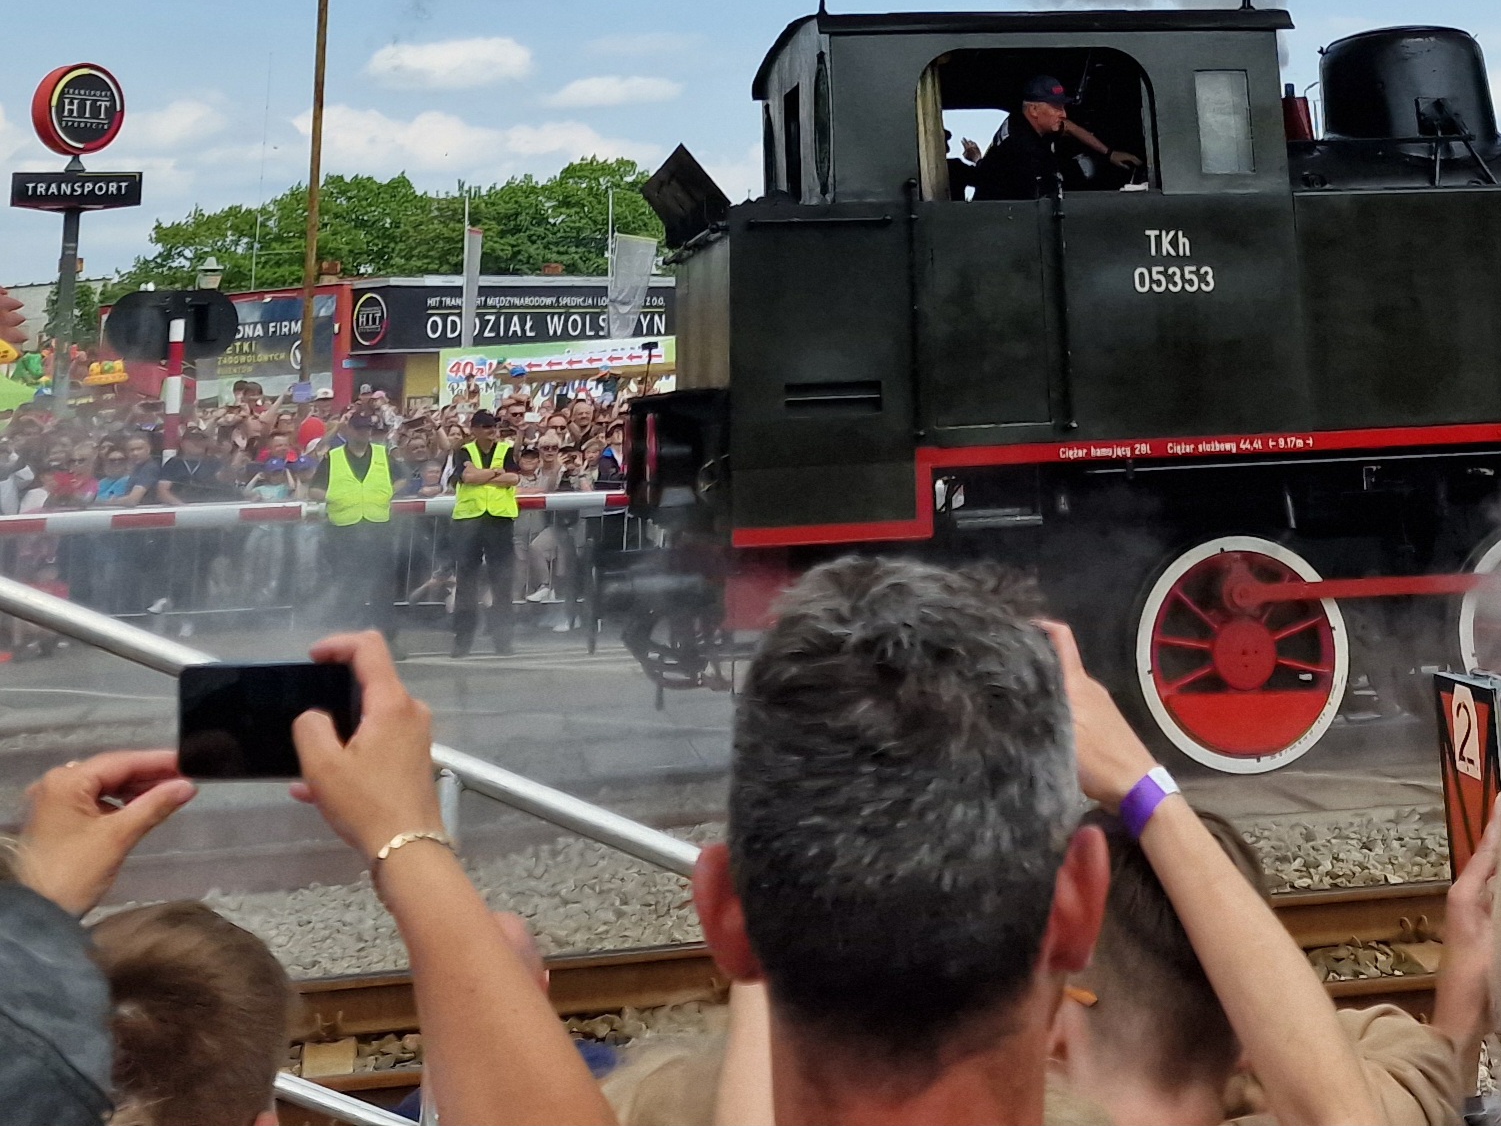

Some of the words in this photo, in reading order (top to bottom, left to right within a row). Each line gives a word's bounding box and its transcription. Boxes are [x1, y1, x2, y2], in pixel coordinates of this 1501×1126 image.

[63, 99, 110, 119] HIT
[25, 182, 129, 196] TRANSPORT
[1144, 229, 1191, 257] TKh
[1133, 265, 1215, 293] 05353
[268, 320, 302, 336] FIRM
[358, 313, 382, 326] HIT
[546, 313, 666, 337] WOLSYN
[1455, 701, 1476, 766] 2
